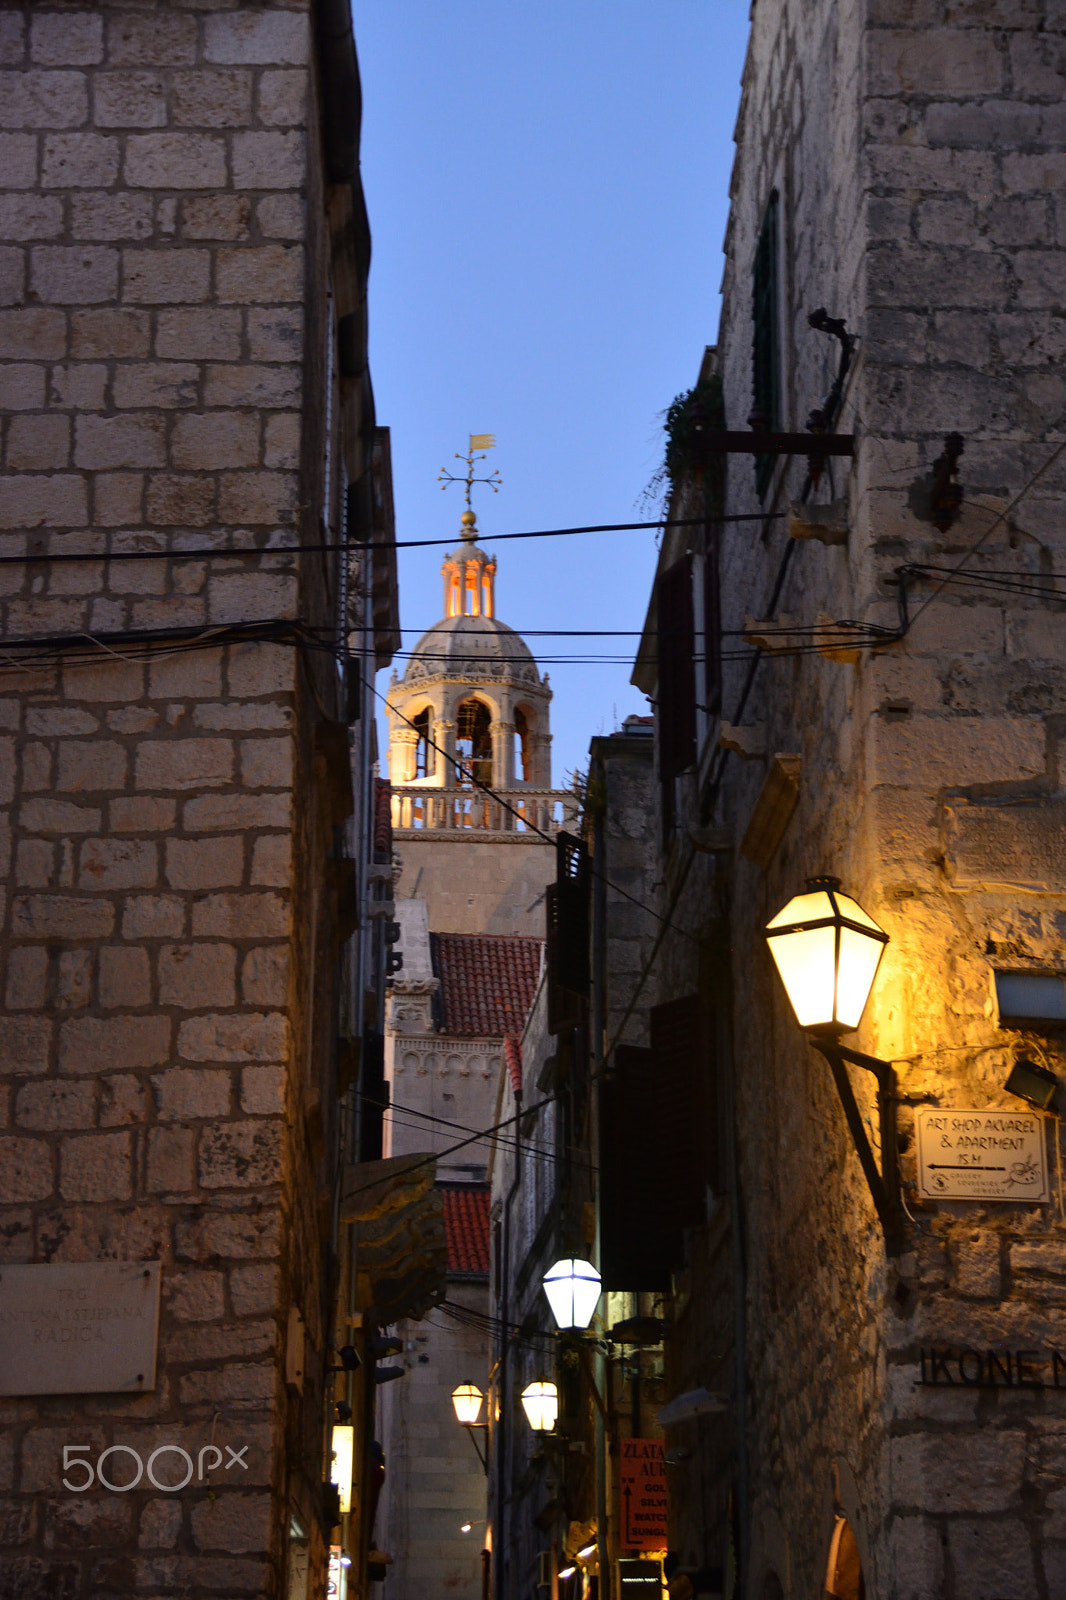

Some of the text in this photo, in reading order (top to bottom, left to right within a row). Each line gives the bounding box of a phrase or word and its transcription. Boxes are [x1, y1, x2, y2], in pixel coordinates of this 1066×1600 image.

[926, 1117, 1035, 1133] ART SHOP AKVAREL
[940, 1134, 1025, 1150] & APARTMENT
